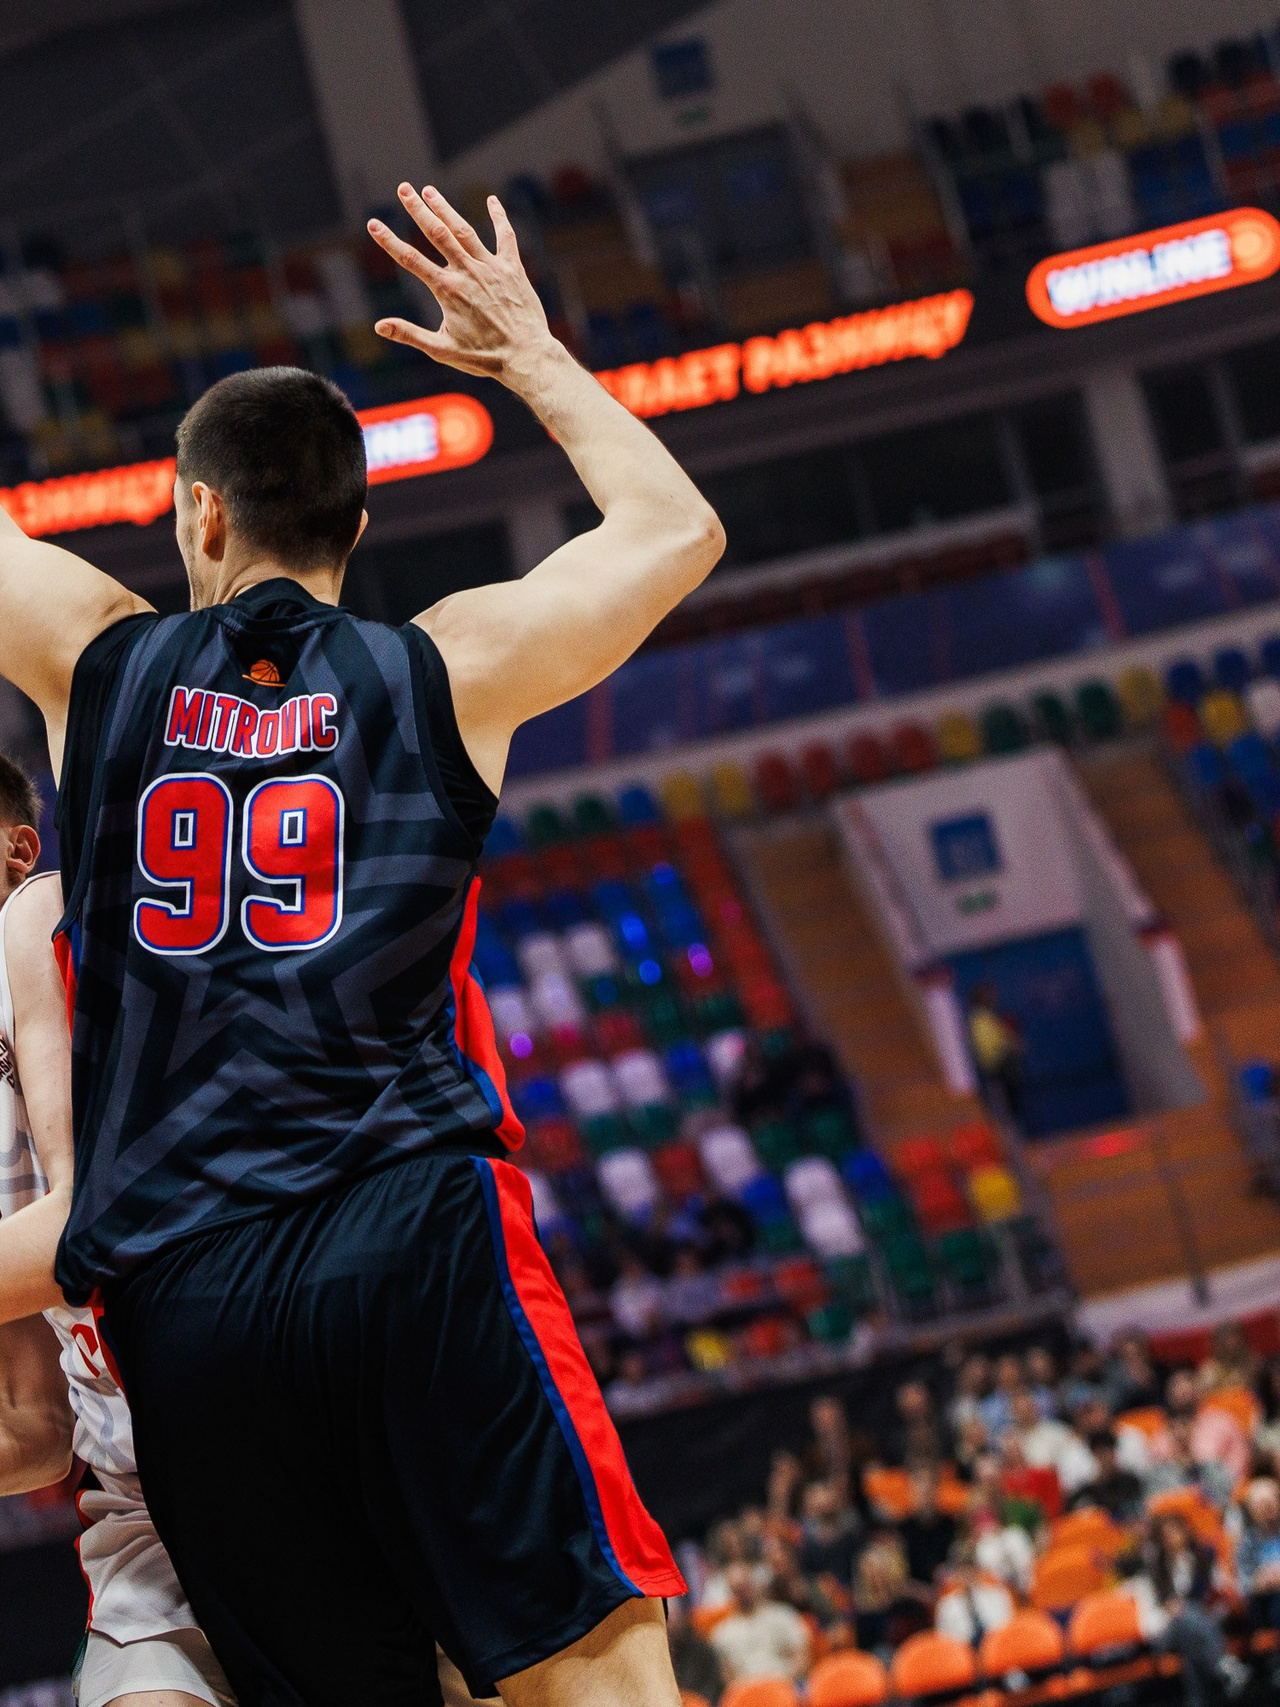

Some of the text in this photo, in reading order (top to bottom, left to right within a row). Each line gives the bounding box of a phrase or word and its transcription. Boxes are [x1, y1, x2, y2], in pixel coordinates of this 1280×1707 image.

[1046, 228, 1233, 317] WINLINE
[742, 288, 975, 394] РАЗНИЦУ
[164, 685, 339, 758] MITROVIC
[133, 772, 345, 956] 99
